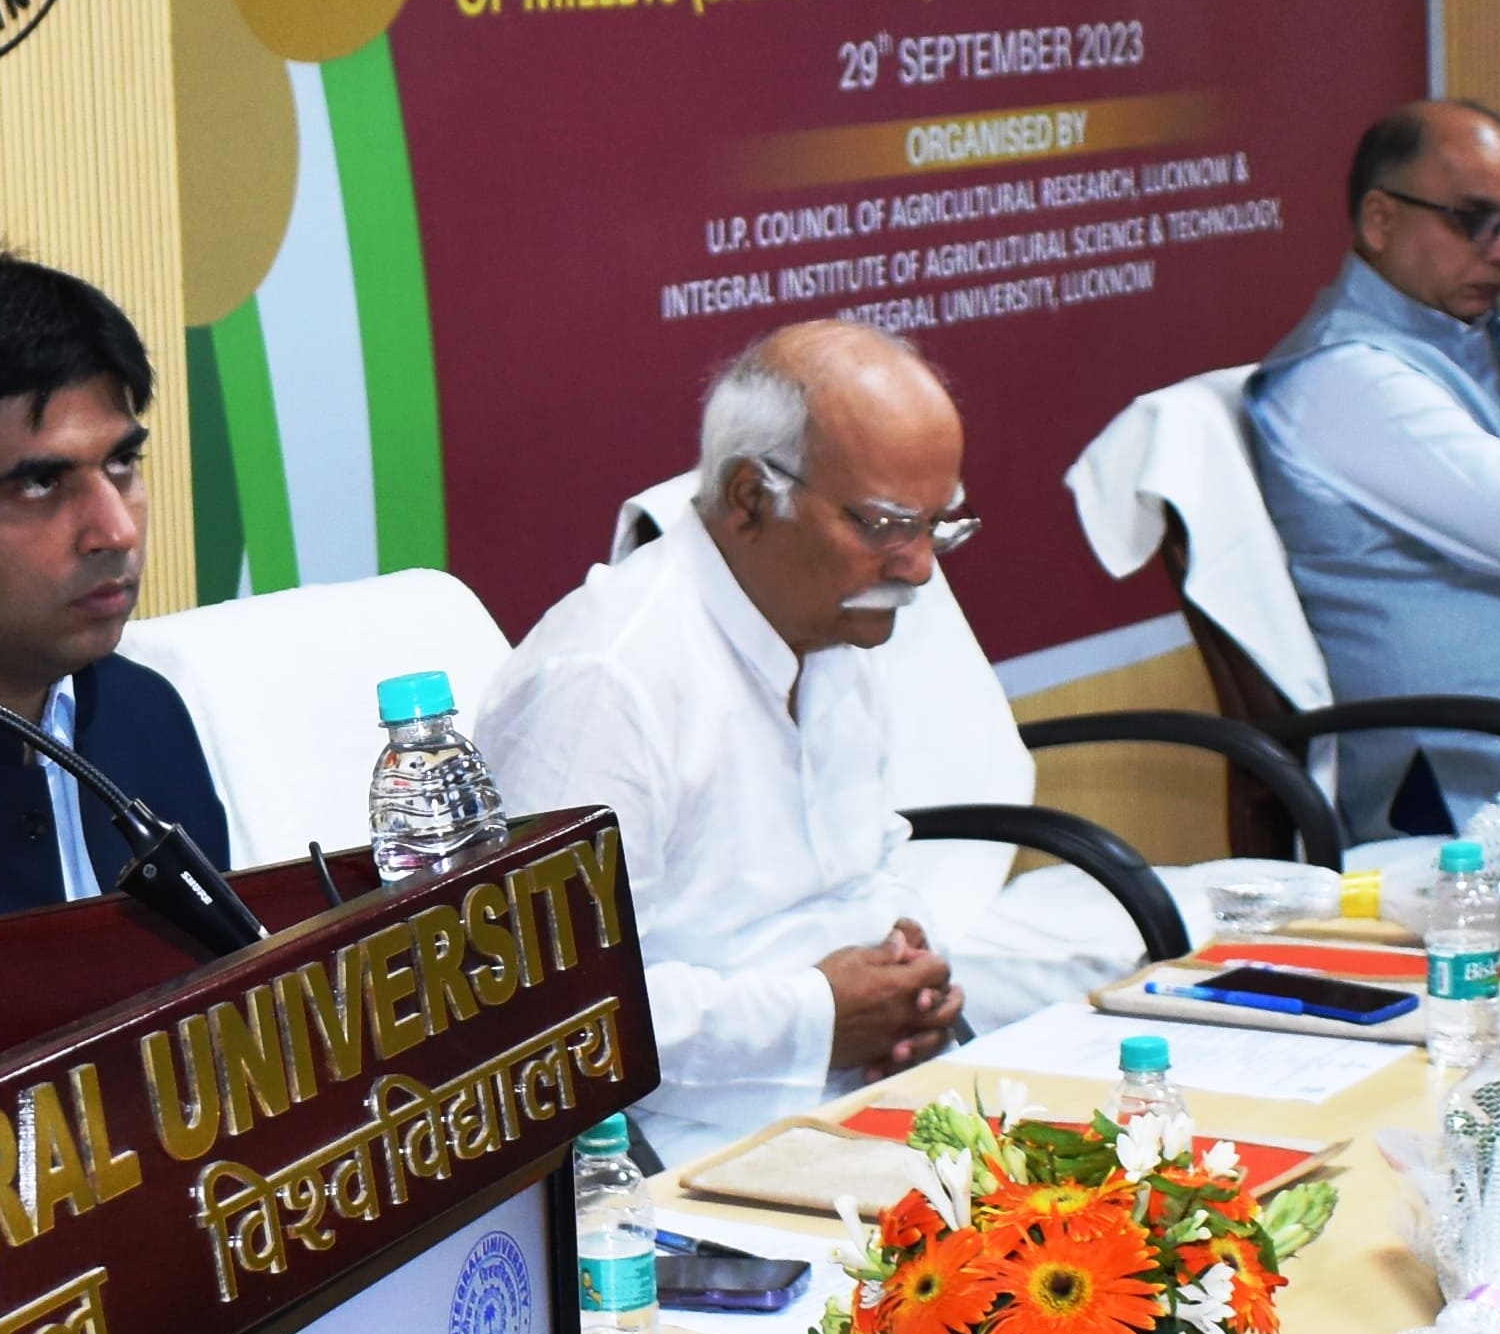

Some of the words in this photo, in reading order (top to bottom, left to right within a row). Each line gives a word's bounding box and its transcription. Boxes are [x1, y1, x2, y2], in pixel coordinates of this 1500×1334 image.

[839, 32, 893, 91] 29th
[899, 29, 1073, 85] SEPTEMBER
[1077, 19, 1145, 68] 2023
[907, 114, 1052, 167] ORGANISED
[1056, 109, 1089, 149] BY
[706, 217, 751, 253] U.P.
[754, 204, 851, 249] COUNCIL
[855, 197, 886, 236] OF
[890, 180, 1037, 229] AGRICULTURAL
[1041, 167, 1139, 208] RESEARCH,
[1142, 154, 1231, 195] LUCKNOW
[661, 272, 774, 320] INTEGRAL
[779, 255, 887, 304] INSTITUTE
[891, 247, 922, 285] OF
[925, 228, 1068, 281] AGRICULTURAL
[1073, 215, 1146, 258] SCIENCE
[940, 273, 1060, 324] UNIVERSITY,
[1062, 261, 1156, 305] LUCKNOW
[140, 827, 627, 1161] UNIVERSITY
[196, 995, 621, 1302] विश्वविद्यालय
[481, 1236, 529, 1308] UNIVERSITY
